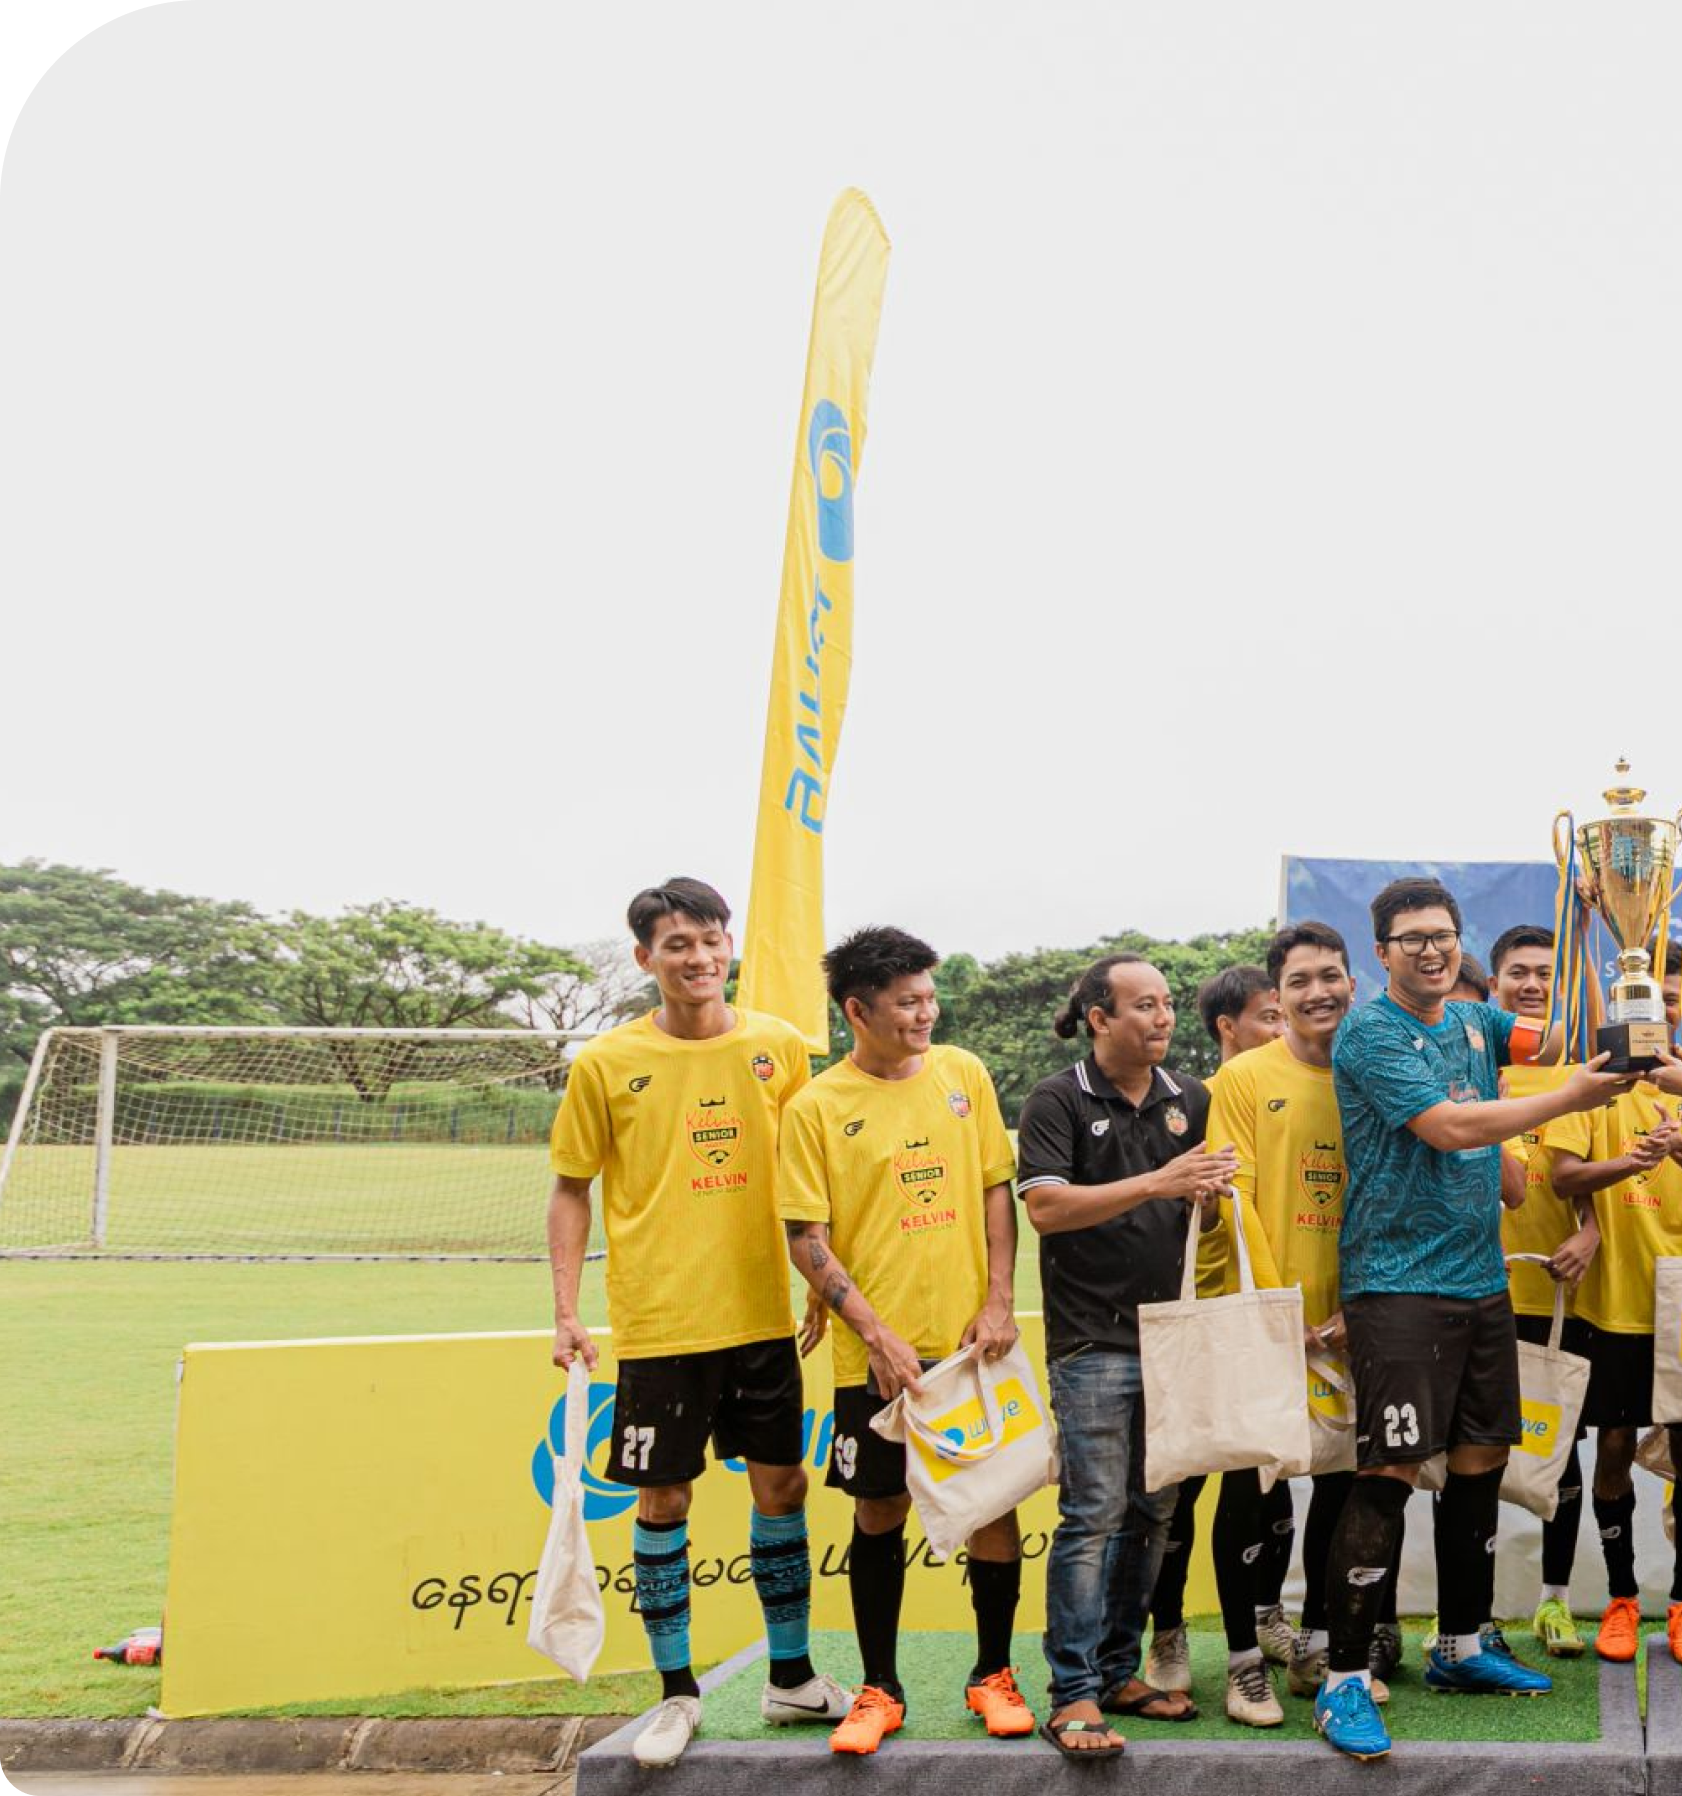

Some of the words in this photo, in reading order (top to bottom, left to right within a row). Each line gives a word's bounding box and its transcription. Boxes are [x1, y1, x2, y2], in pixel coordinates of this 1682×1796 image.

[691, 1172, 748, 1191] KELVIN
[901, 1208, 957, 1230] KELVIN
[1383, 1401, 1420, 1447] 23
[622, 1425, 656, 1471] 27
